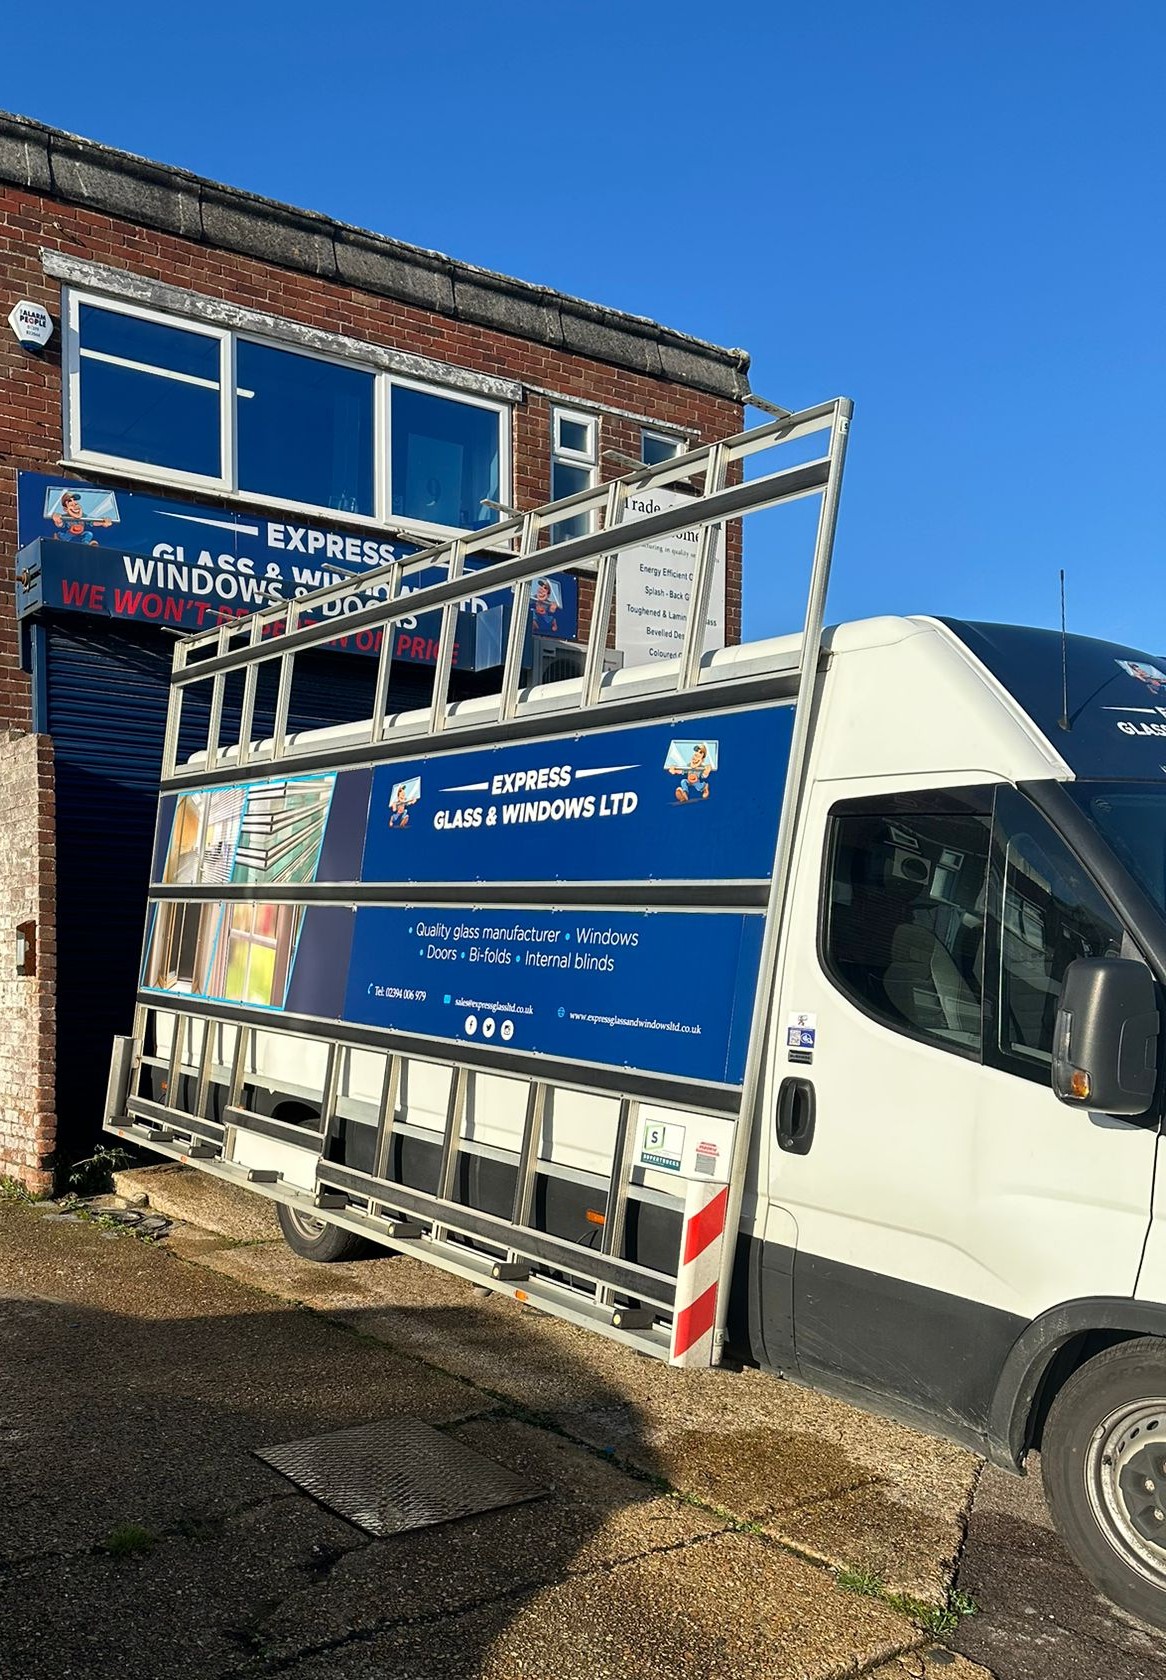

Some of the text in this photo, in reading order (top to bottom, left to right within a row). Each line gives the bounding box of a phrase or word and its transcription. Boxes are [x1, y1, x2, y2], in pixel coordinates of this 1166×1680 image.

[20, 315, 46, 328] PEOPLE
[23, 310, 46, 320] ALARM
[268, 522, 396, 566] EXPRESS
[640, 563, 661, 577] Energy
[662, 567, 689, 581] Efficient
[123, 556, 284, 608] WINDOWS
[645, 585, 665, 597] Splash
[669, 590, 683, 600] Back
[627, 604, 661, 617] Toughened
[662, 610, 667, 618] &
[62, 579, 106, 610] WE
[114, 588, 211, 626] WON'T
[397, 634, 460, 666] PRIE
[646, 626, 673, 639] Bevelled
[649, 648, 678, 660] Coloured
[491, 765, 572, 795] EXPRESS
[433, 791, 639, 830] GLASS & WINDOWS LTD
[416, 922, 639, 946] Quality glass manufacturer Windows
[426, 944, 615, 972] Doors Bi-folds Internal blinds
[374, 985, 426, 1001] Tel: 02394 006 979
[455, 998, 533, 1015] sales@expressglassltd.co.uk
[569, 1011, 701, 1034] www.expressglassandwindowsltd.co.uk
[651, 1130, 658, 1143] S
